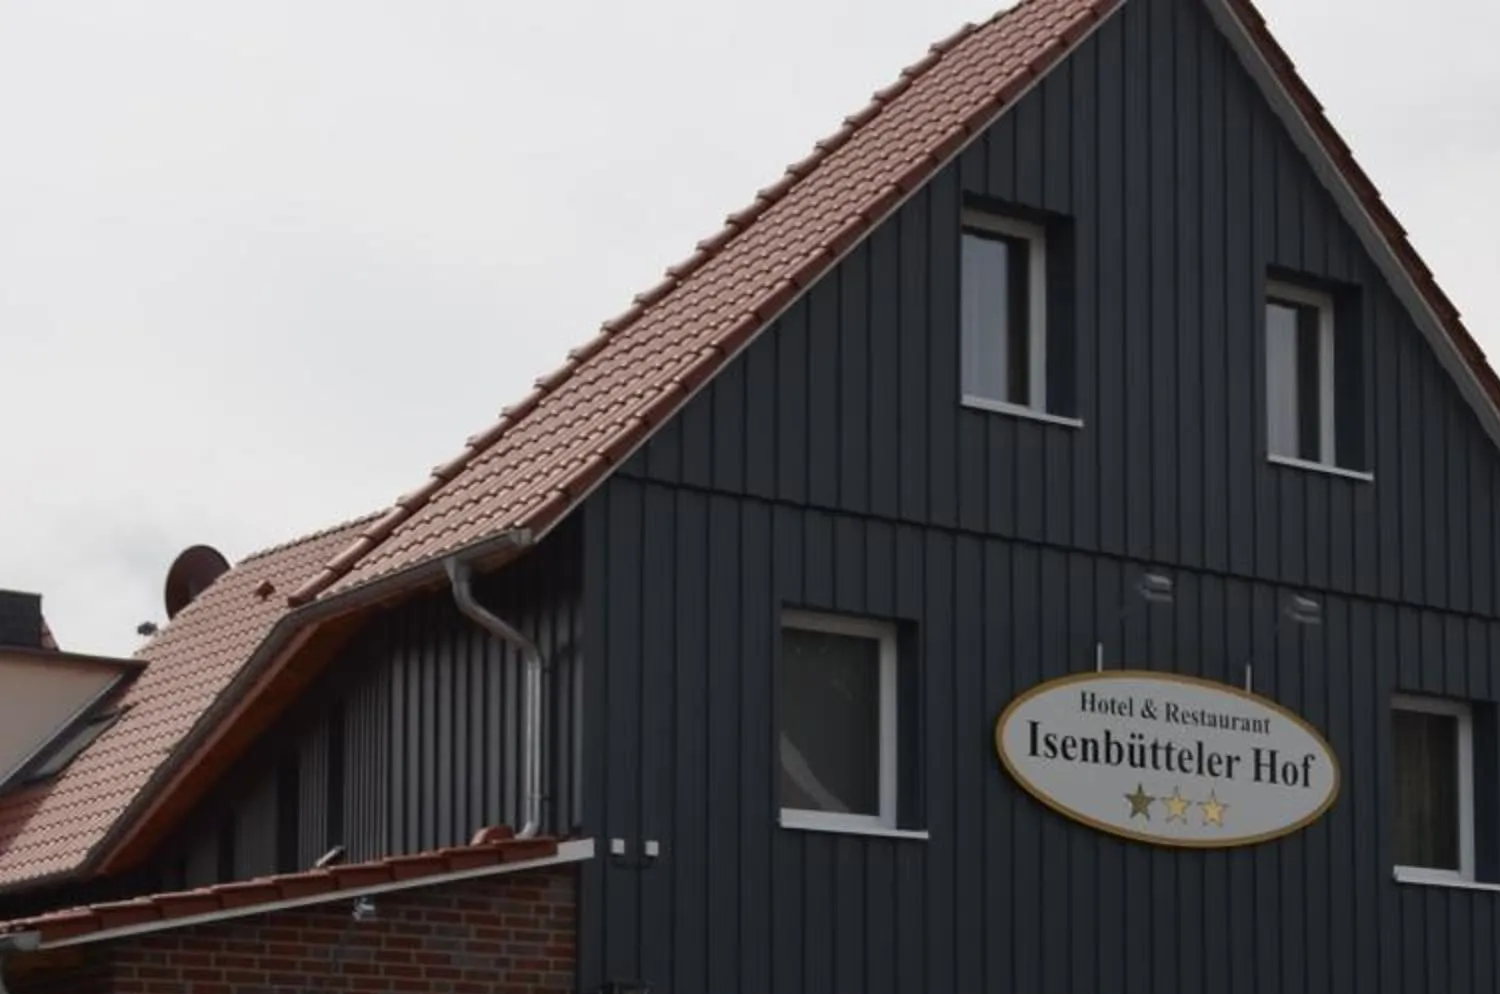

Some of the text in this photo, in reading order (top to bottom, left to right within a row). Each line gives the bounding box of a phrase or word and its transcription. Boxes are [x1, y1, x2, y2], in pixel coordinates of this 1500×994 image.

[1080, 691, 1271, 735] Hotel & Restaurant
[1027, 720, 1316, 788] Isenbütteler Hof
